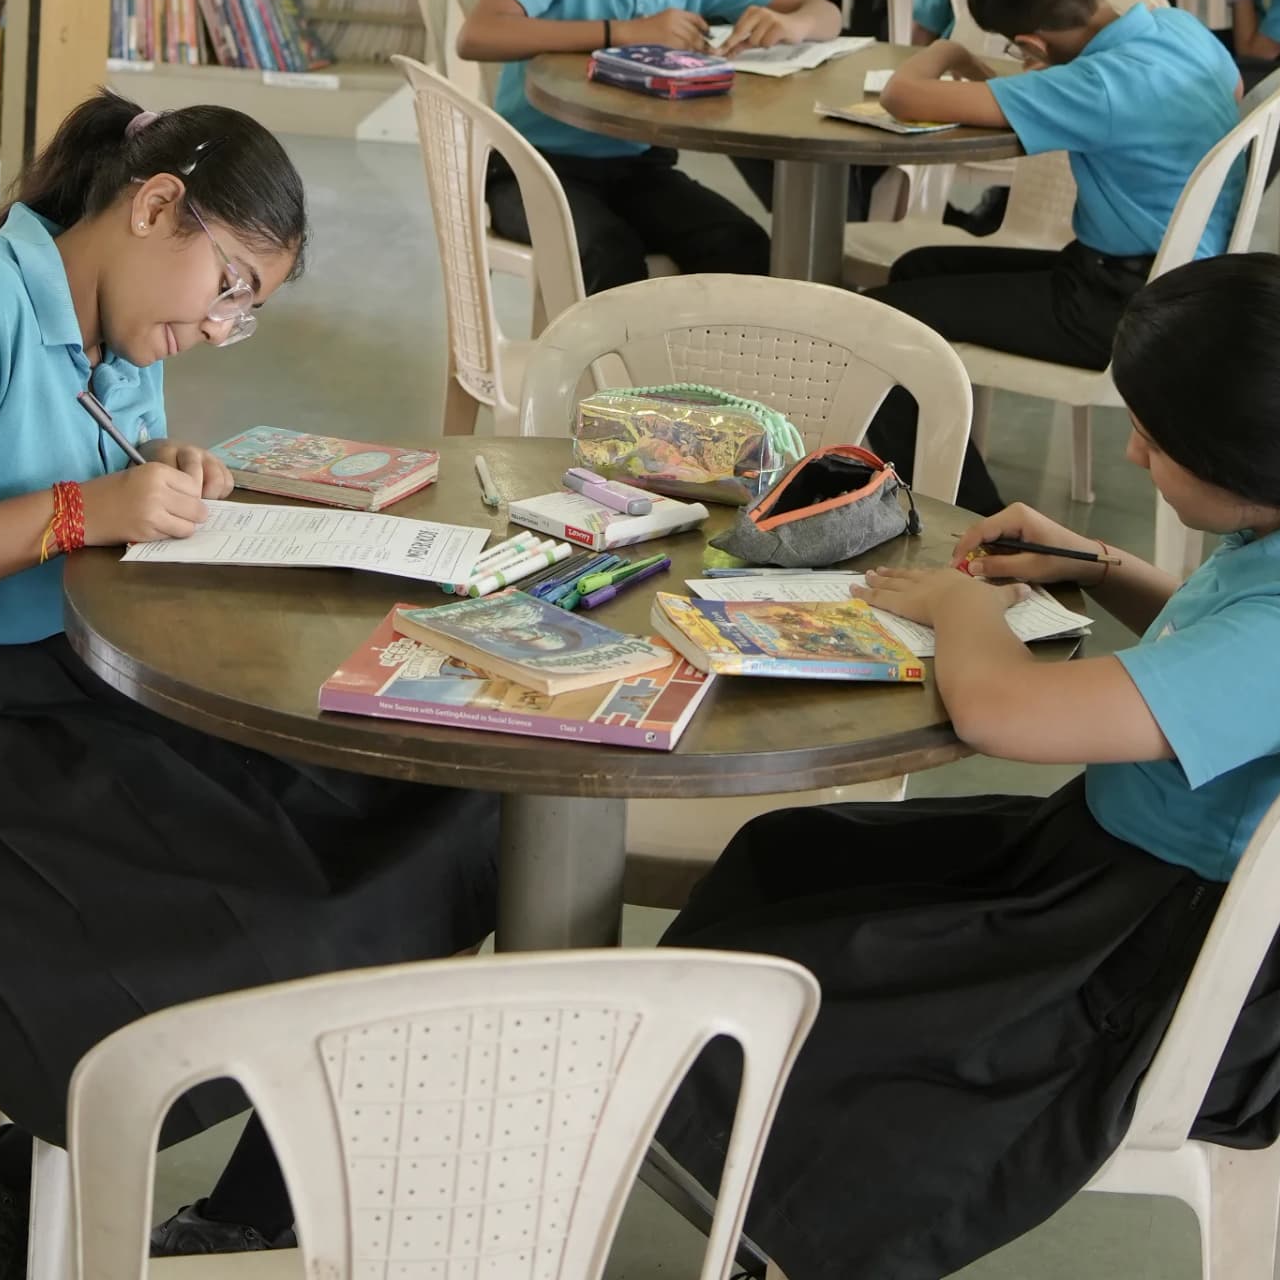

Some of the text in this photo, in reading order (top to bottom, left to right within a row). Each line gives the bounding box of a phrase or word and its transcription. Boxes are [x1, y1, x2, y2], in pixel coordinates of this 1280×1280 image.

[379, 701, 393, 710] New
[394, 703, 419, 714] Success
[420, 705, 434, 716] with
[488, 713, 507, 723] Social
[508, 716, 532, 727] Science
[560, 724, 576, 733] Class
